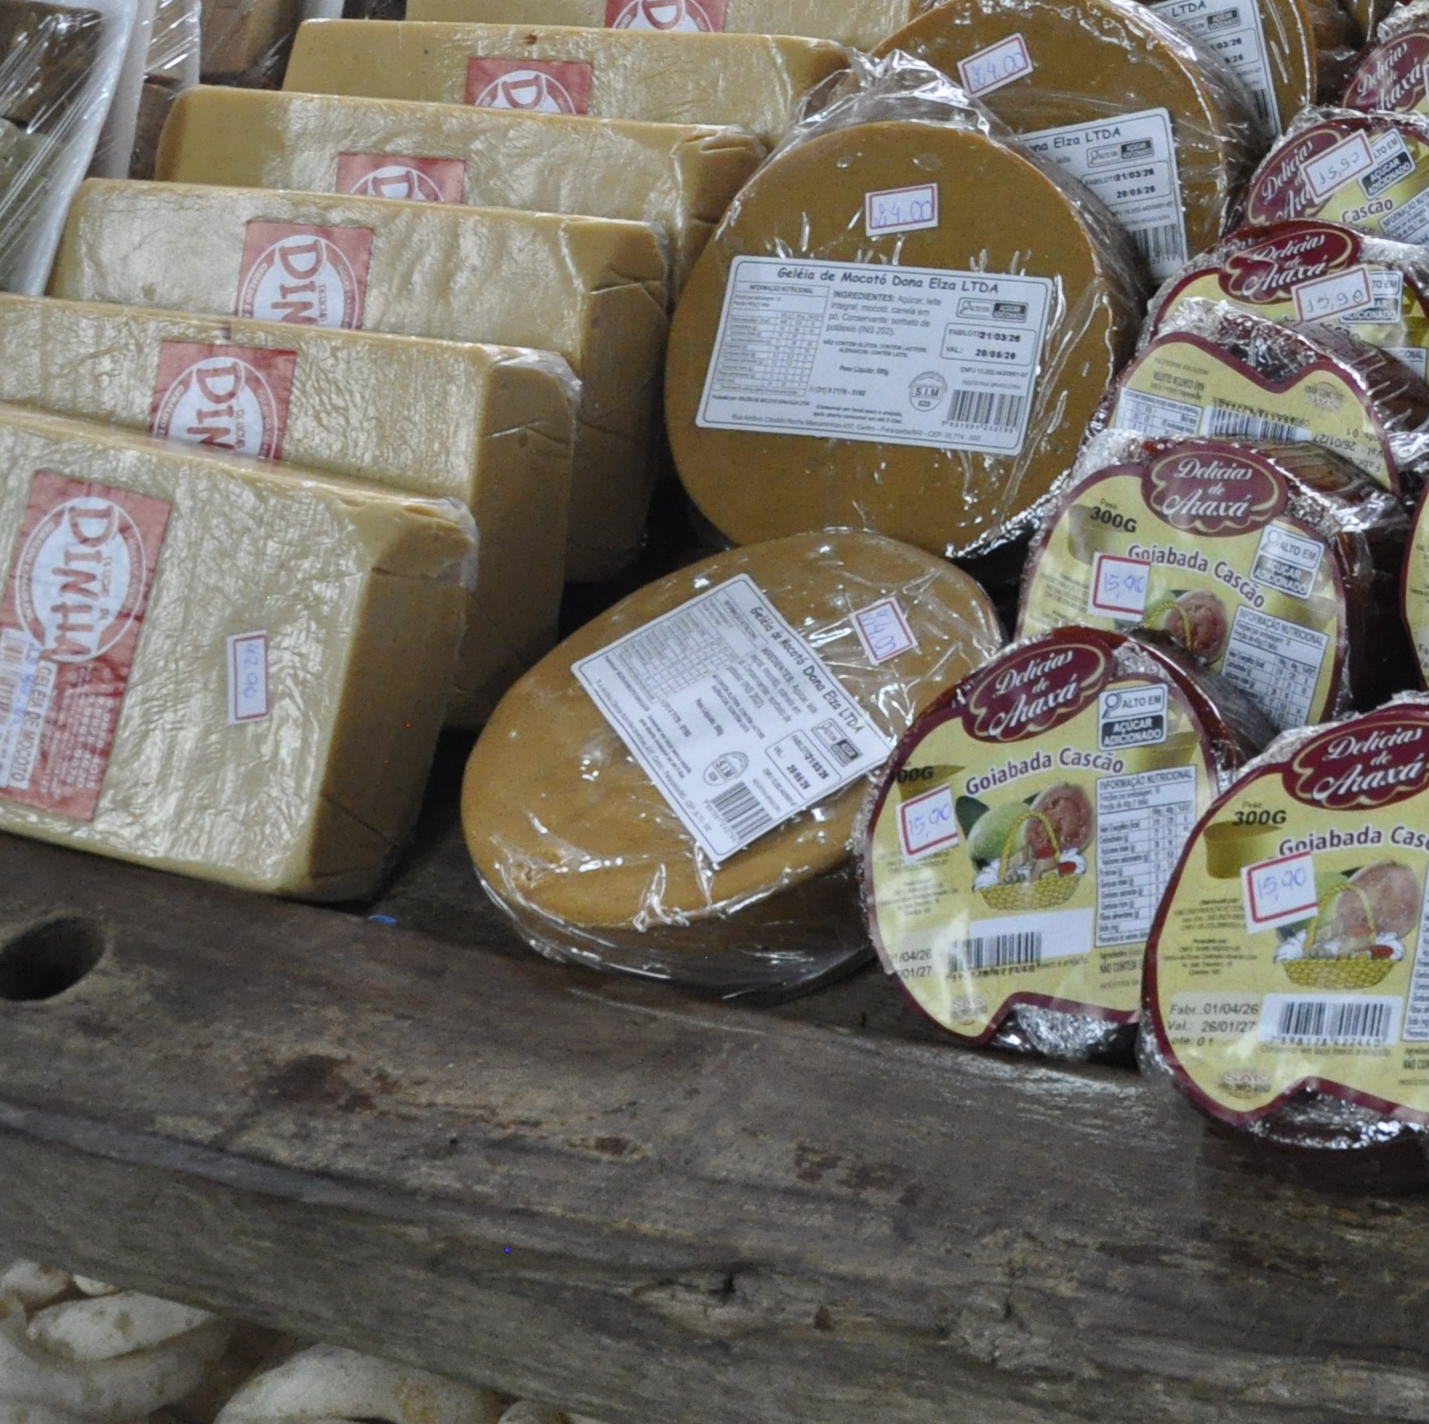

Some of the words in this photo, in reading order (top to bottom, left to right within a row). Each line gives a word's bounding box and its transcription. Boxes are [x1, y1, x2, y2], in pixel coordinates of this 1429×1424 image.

[1172, 1, 1207, 18] LTDA
[777, 268, 815, 280] Geléia
[819, 271, 836, 282] de
[841, 272, 886, 286] Mocotó
[892, 276, 924, 288] Dona
[928, 278, 956, 291] Elza
[961, 280, 999, 294] LTDA
[1177, 458, 1253, 482] Delícias
[1162, 484, 1250, 519] Araxá
[1088, 506, 1137, 534] 300G
[39, 506, 118, 659] DINHA
[1127, 543, 1211, 574] Goiabada
[1214, 560, 1265, 609] Cascão
[996, 649, 1075, 694] Delícias
[988, 677, 1079, 735] Araxá
[1104, 728, 1162, 745] ADICIONADO
[1112, 718, 1153, 735] AÇÚCAR
[1327, 726, 1423, 761] Delícias
[964, 754, 1054, 798] Goiabada
[1059, 747, 1126, 774] Cascão
[1312, 757, 1426, 801] Araxá
[1232, 810, 1287, 826] 300G
[1278, 825, 1383, 857] Goiabada
[1201, 1020, 1256, 1033] 26/01/27
